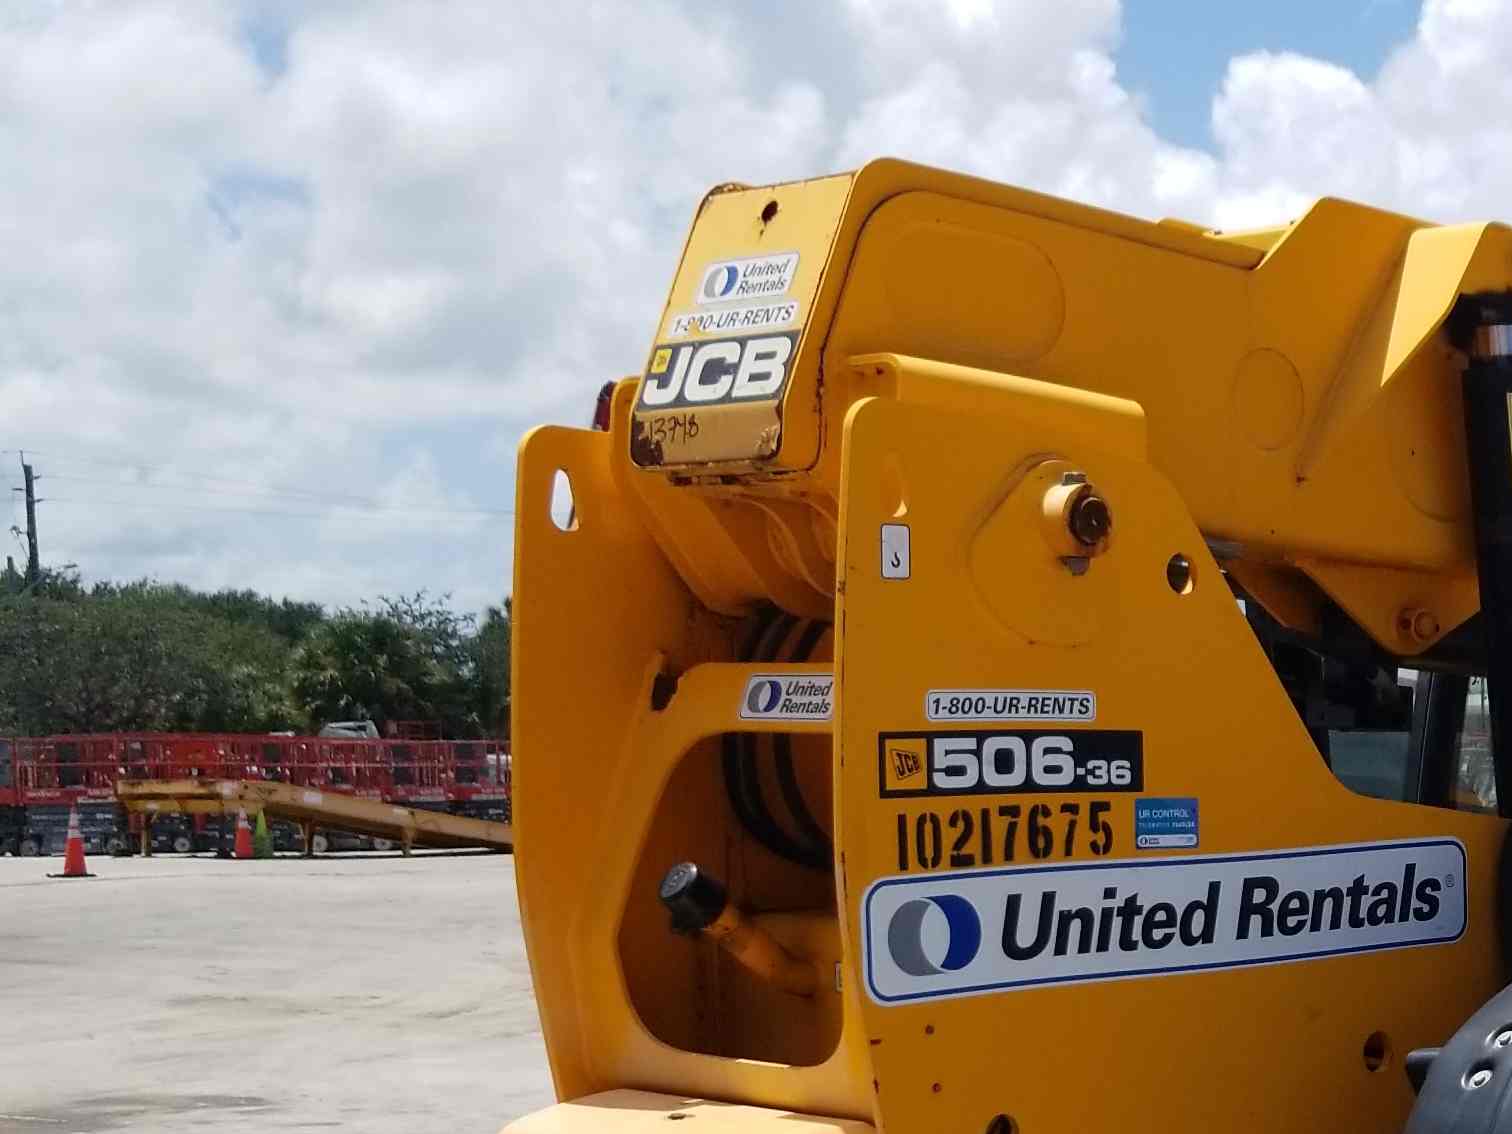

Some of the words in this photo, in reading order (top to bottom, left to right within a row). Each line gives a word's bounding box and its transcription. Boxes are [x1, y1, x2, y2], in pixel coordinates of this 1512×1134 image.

[742, 258, 790, 278] United
[736, 276, 787, 295] Rentals
[643, 336, 792, 405] JCB
[785, 681, 832, 697] United
[779, 698, 831, 714] Rentals
[932, 696, 1091, 716] 1-800-UR-RENTS
[896, 751, 920, 777] JCB
[932, 736, 1132, 789] 506-36
[897, 801, 1113, 870] 10217675
[1001, 880, 1221, 960] United
[1237, 863, 1442, 941] Rentals
